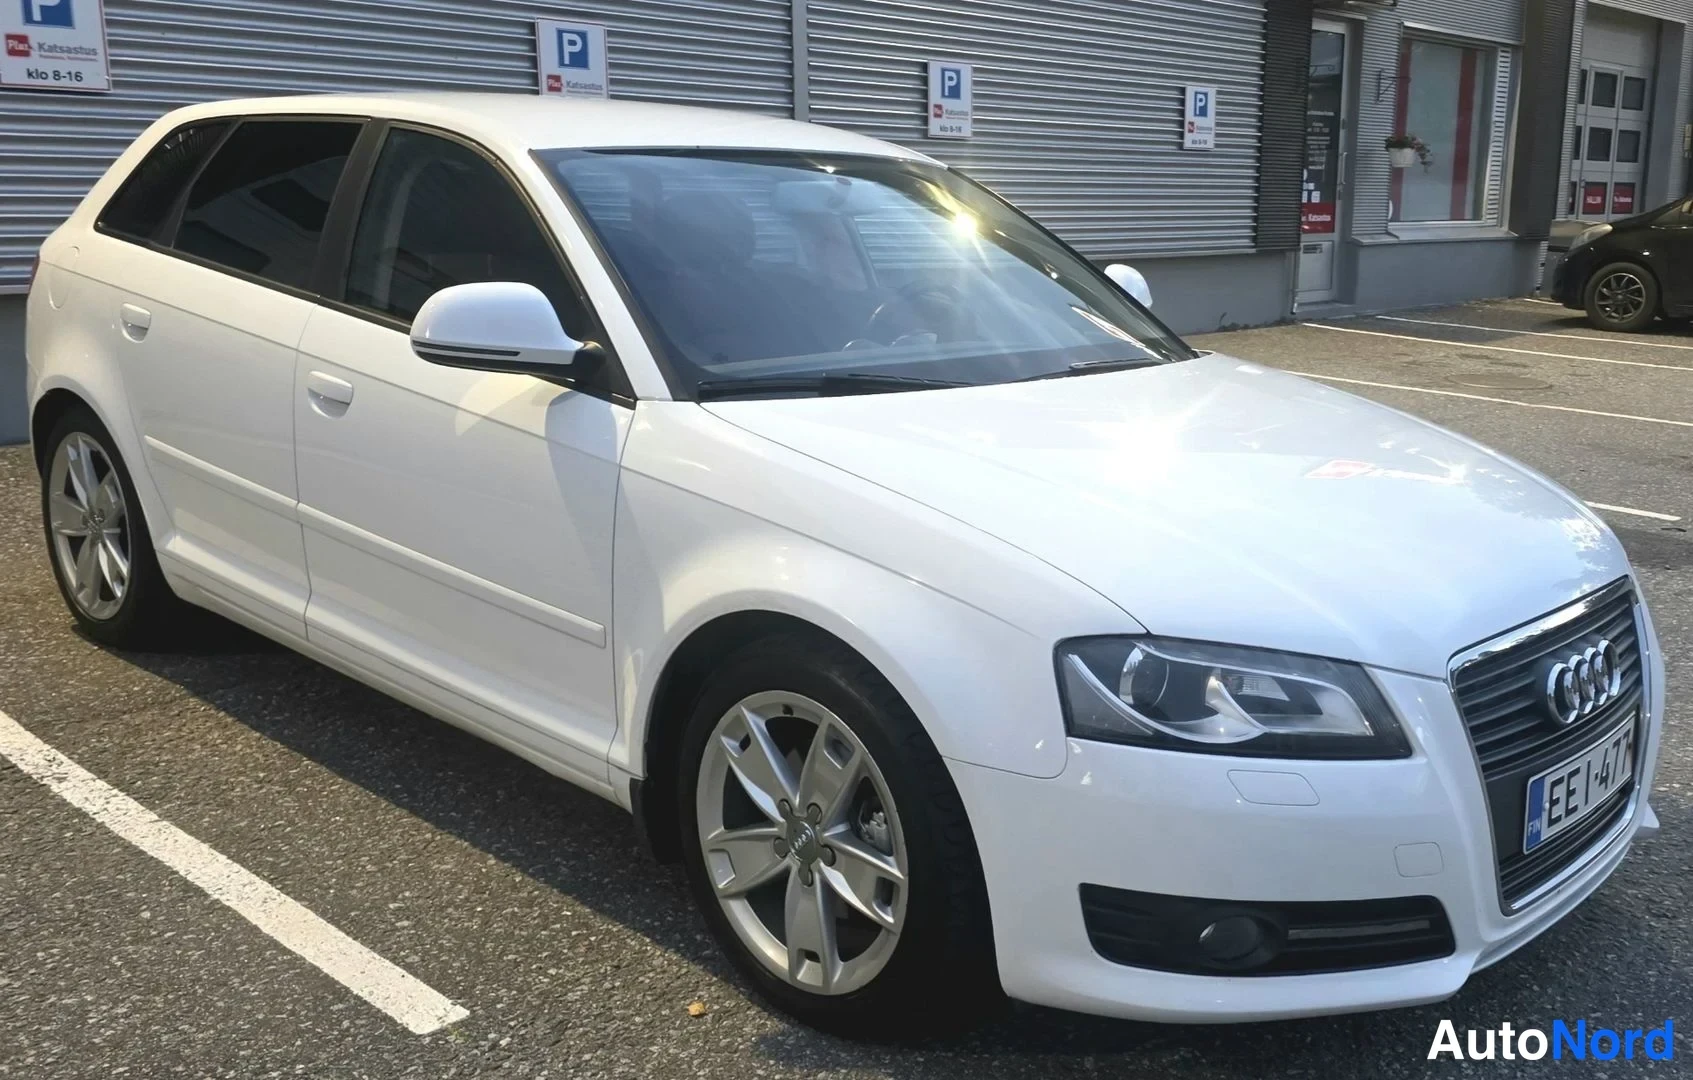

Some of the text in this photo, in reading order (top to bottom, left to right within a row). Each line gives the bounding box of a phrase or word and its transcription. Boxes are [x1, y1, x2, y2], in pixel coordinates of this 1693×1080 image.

[37, 42, 98, 56] Katsastus
[562, 32, 583, 65] P
[26, 68, 84, 82] klo 8-16
[944, 70, 957, 96] P
[1196, 93, 1206, 115] P
[1548, 727, 1632, 829] EEI-477
[1528, 818, 1541, 837] FIN
